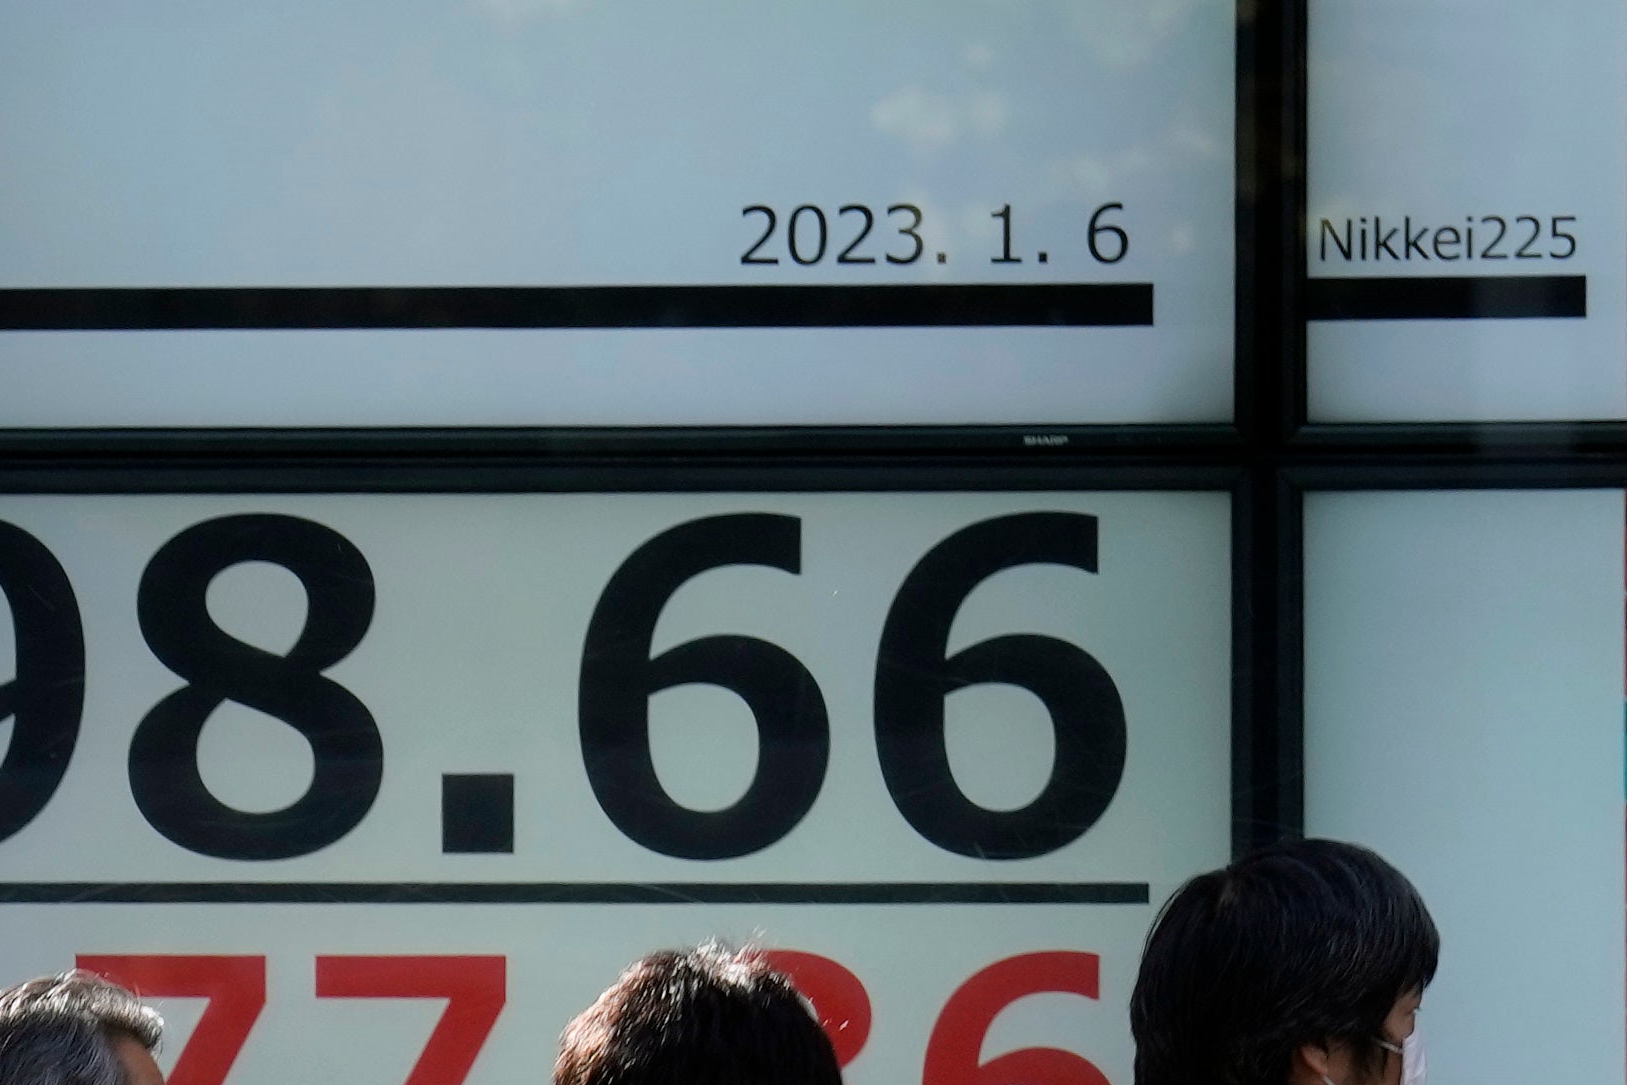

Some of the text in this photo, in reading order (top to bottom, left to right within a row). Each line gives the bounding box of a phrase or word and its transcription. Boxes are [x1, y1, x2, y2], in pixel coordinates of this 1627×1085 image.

[739, 200, 1131, 267] 2023. 1. 6
[1318, 214, 1578, 263] Nikkei225
